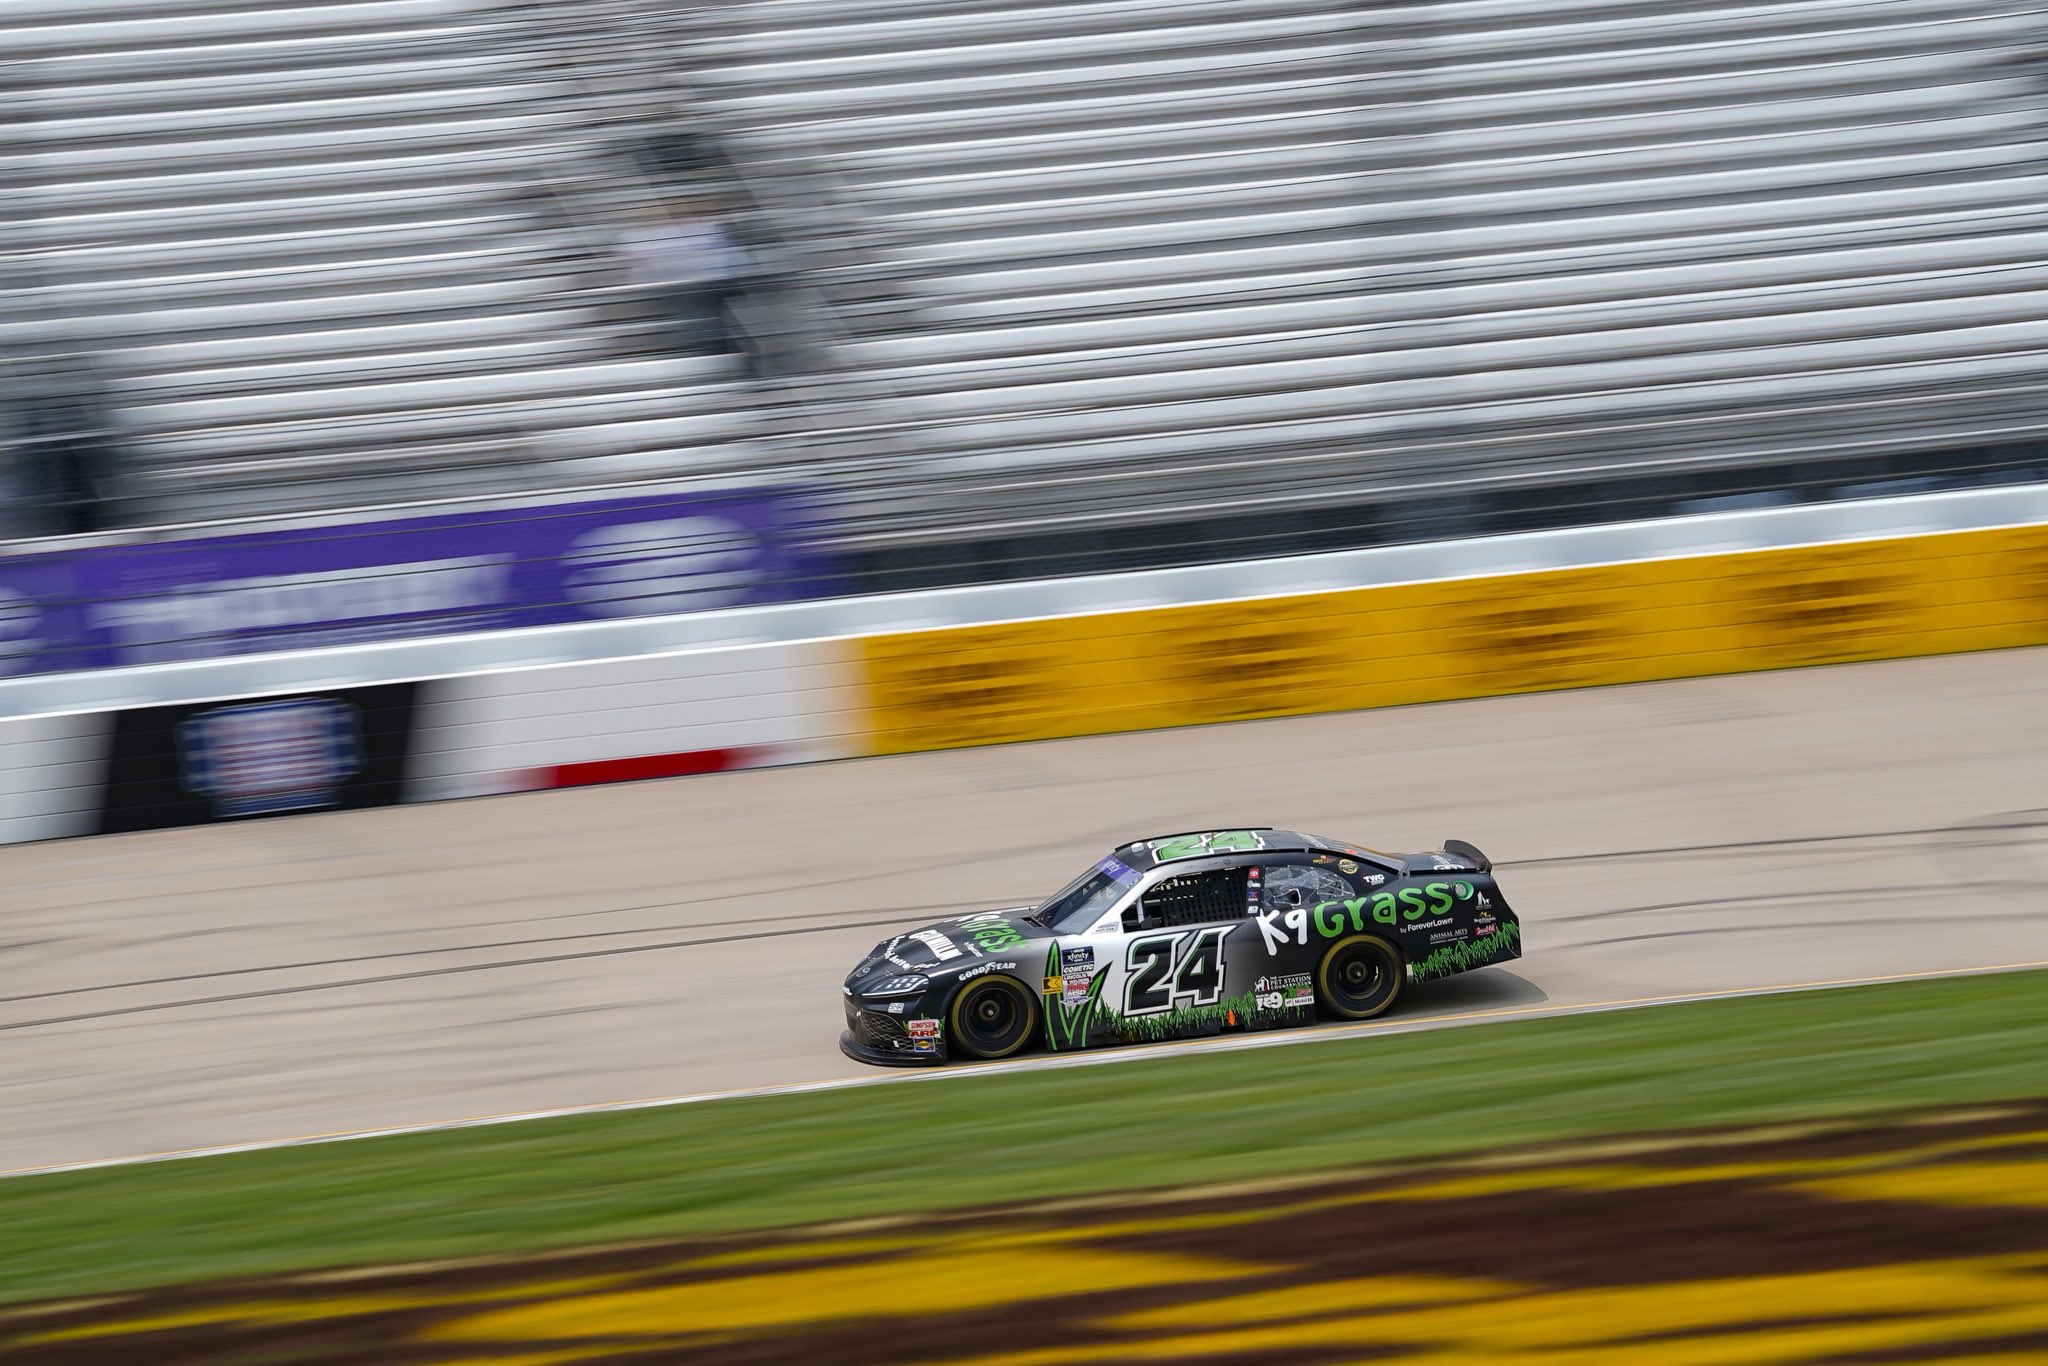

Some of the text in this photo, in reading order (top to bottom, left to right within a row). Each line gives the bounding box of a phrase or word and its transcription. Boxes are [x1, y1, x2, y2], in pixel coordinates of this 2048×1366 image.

[1363, 873, 1385, 884] TWC
[1407, 917, 1453, 932] ForeverLawn
[1430, 930, 1454, 940] ANIMAL
[958, 961, 1017, 981] GOODYEAR
[1063, 964, 1094, 974] COMETIC
[1123, 924, 1238, 1017] 24
[1283, 975, 1312, 985] STATION
[910, 1021, 936, 1029] SIMPSON
